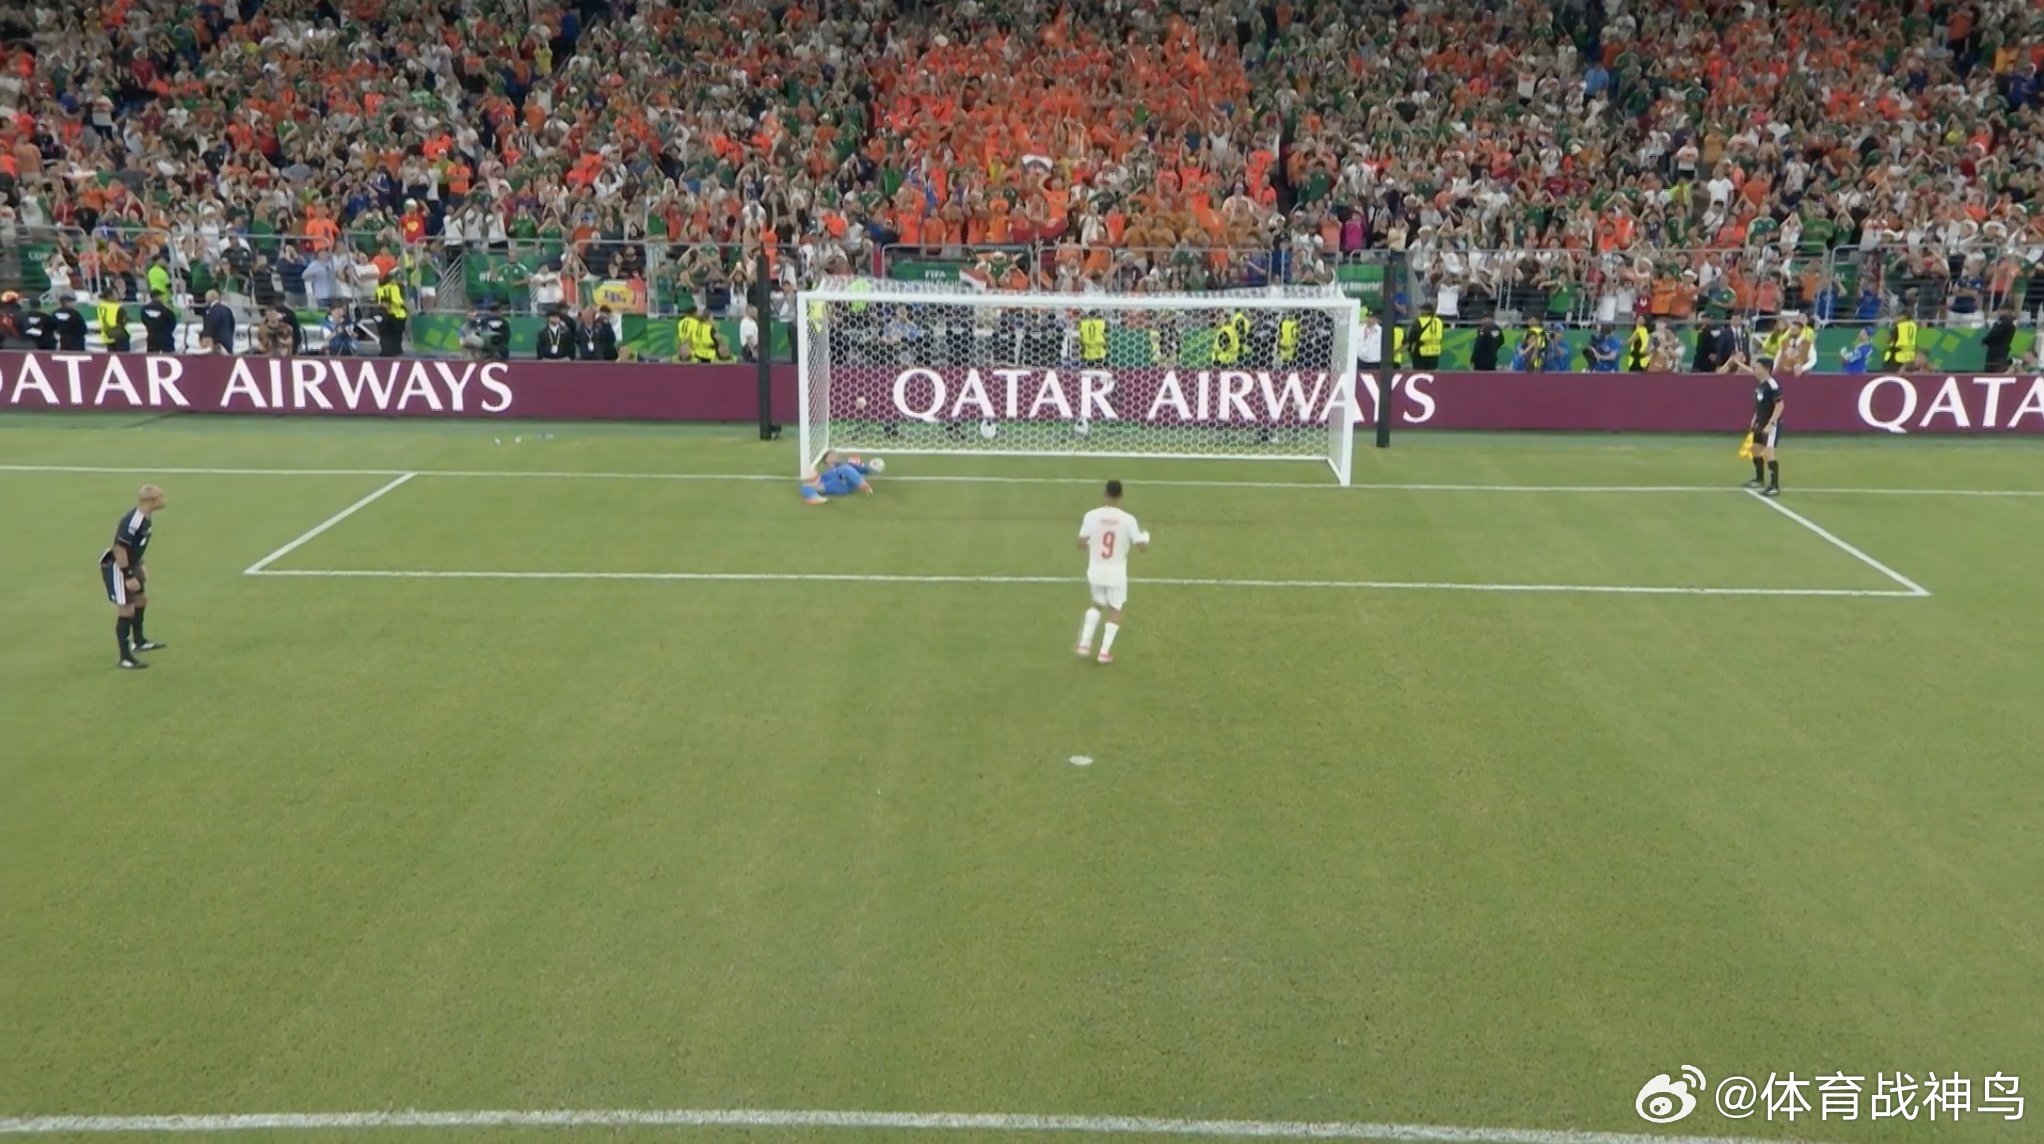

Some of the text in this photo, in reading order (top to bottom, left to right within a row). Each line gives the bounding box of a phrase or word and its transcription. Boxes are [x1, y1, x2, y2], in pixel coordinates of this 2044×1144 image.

[0, 353, 513, 412] ATAR AIRWAYS
[893, 367, 1436, 423] QATAR AIRWAYS
[1101, 530, 1116, 560] 9
